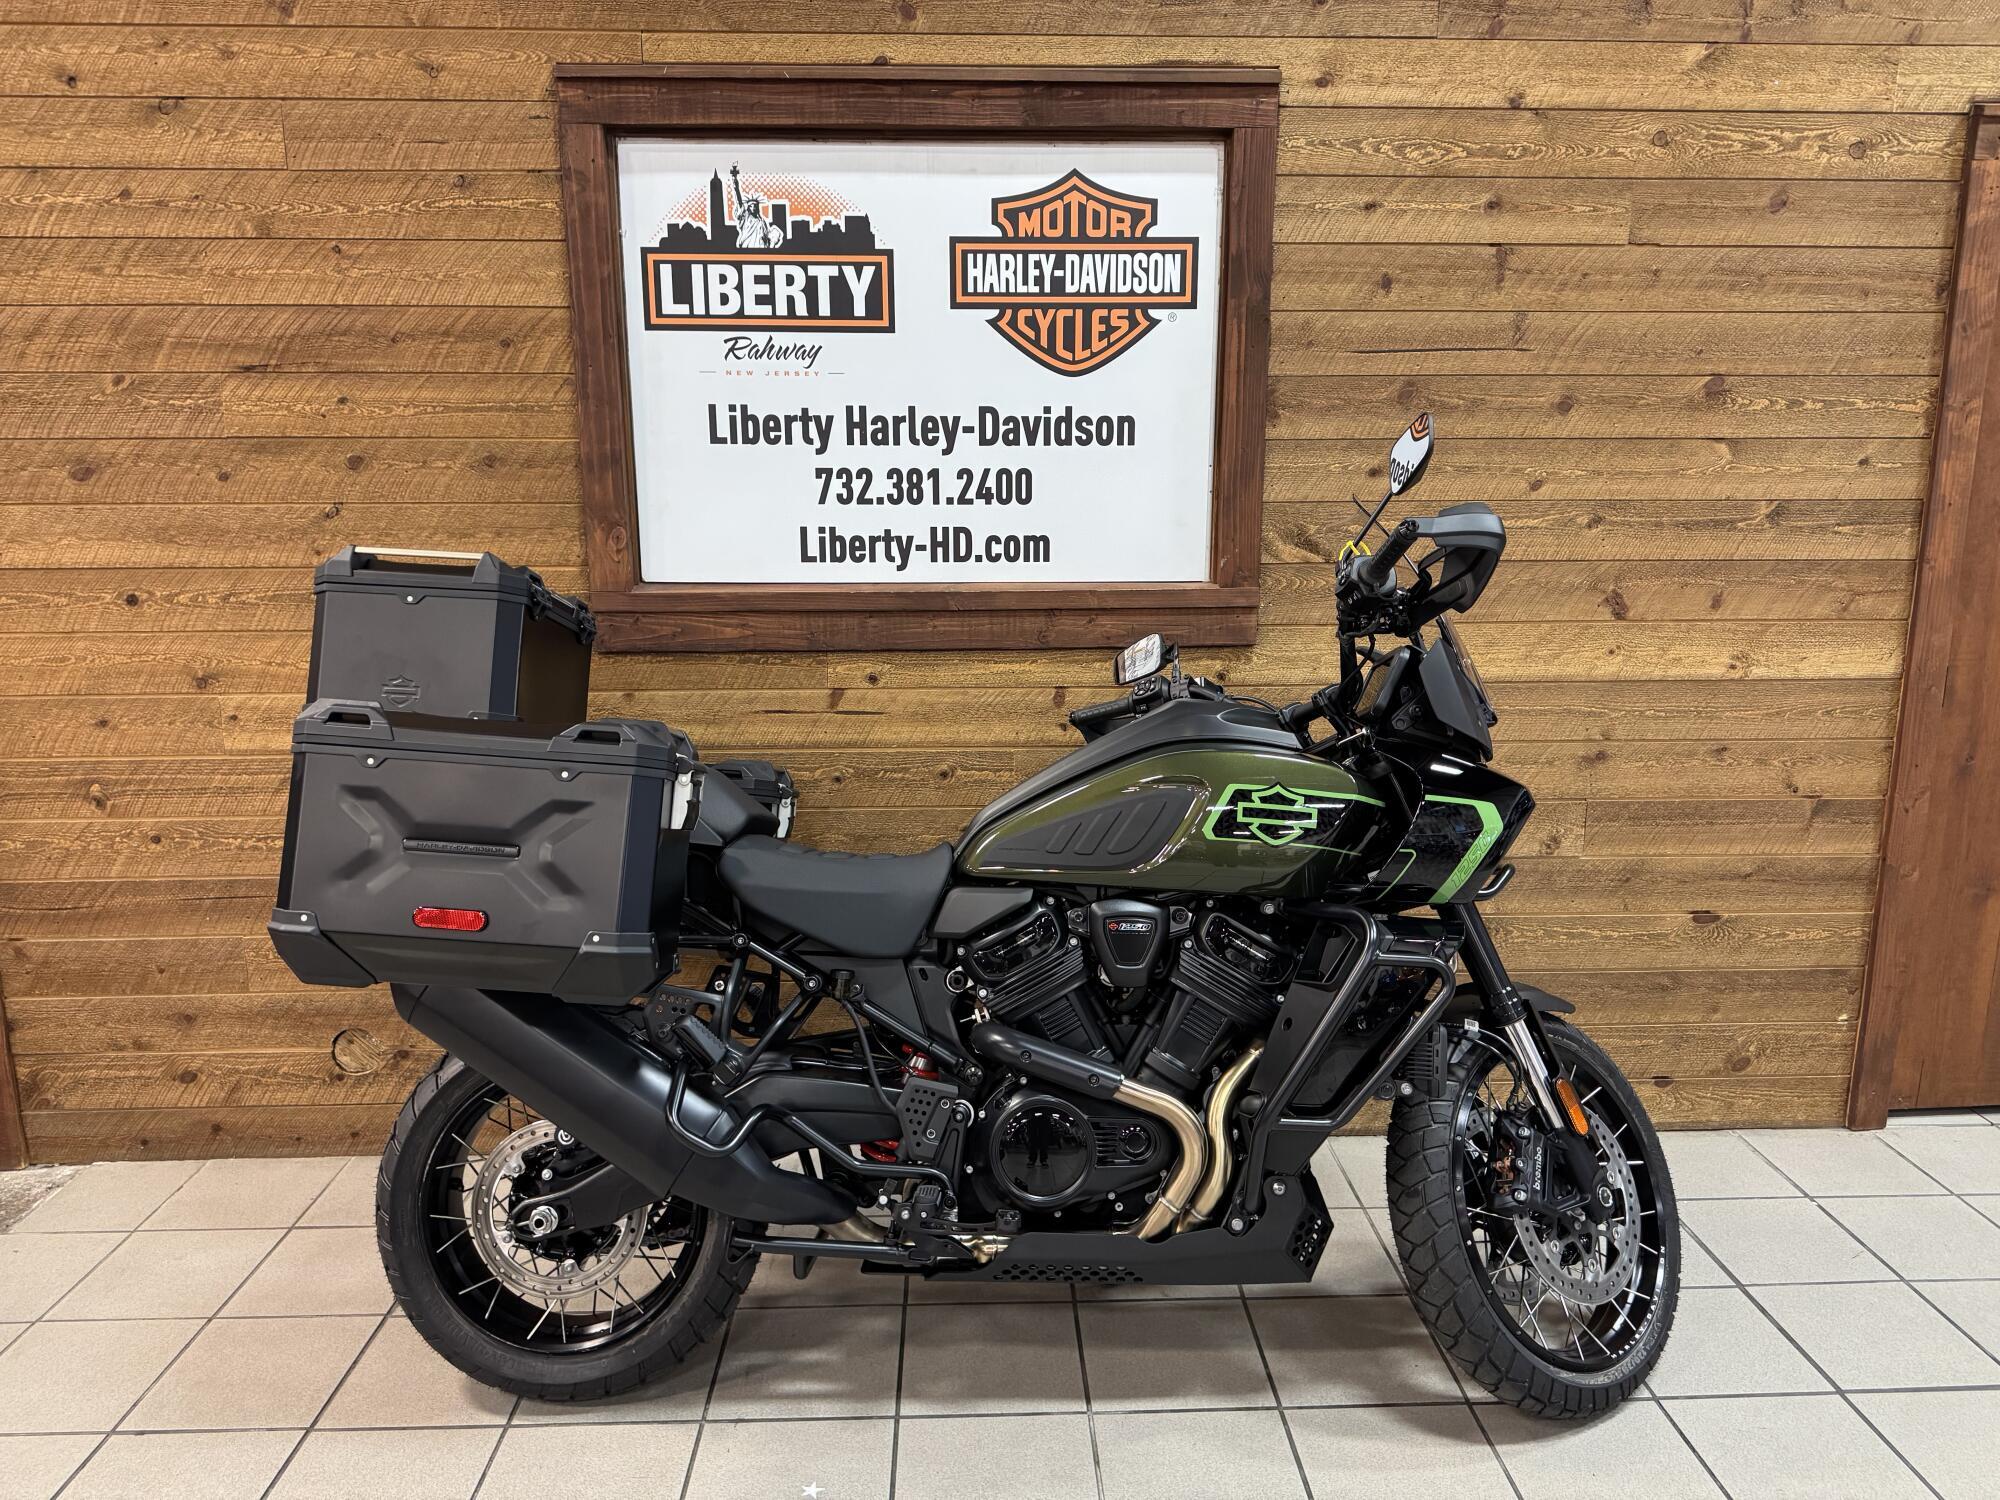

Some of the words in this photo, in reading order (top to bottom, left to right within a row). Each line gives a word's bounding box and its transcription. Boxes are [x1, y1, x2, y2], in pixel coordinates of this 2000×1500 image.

[1018, 190, 1132, 238] MOTOR
[659, 263, 877, 318] LIBERTY
[966, 252, 1182, 294] HARLEY-DAVIDSON
[723, 334, 823, 369] Rahway
[1017, 308, 1130, 362] CYCLES
[707, 403, 835, 455] Liberty
[845, 405, 1137, 456] Harley-Davidson
[814, 467, 1034, 506] 732.381.2400
[799, 526, 1052, 572] Liberty-HD.com
[1119, 923, 1151, 931] 1250
[1533, 1146, 1542, 1191] brembo
